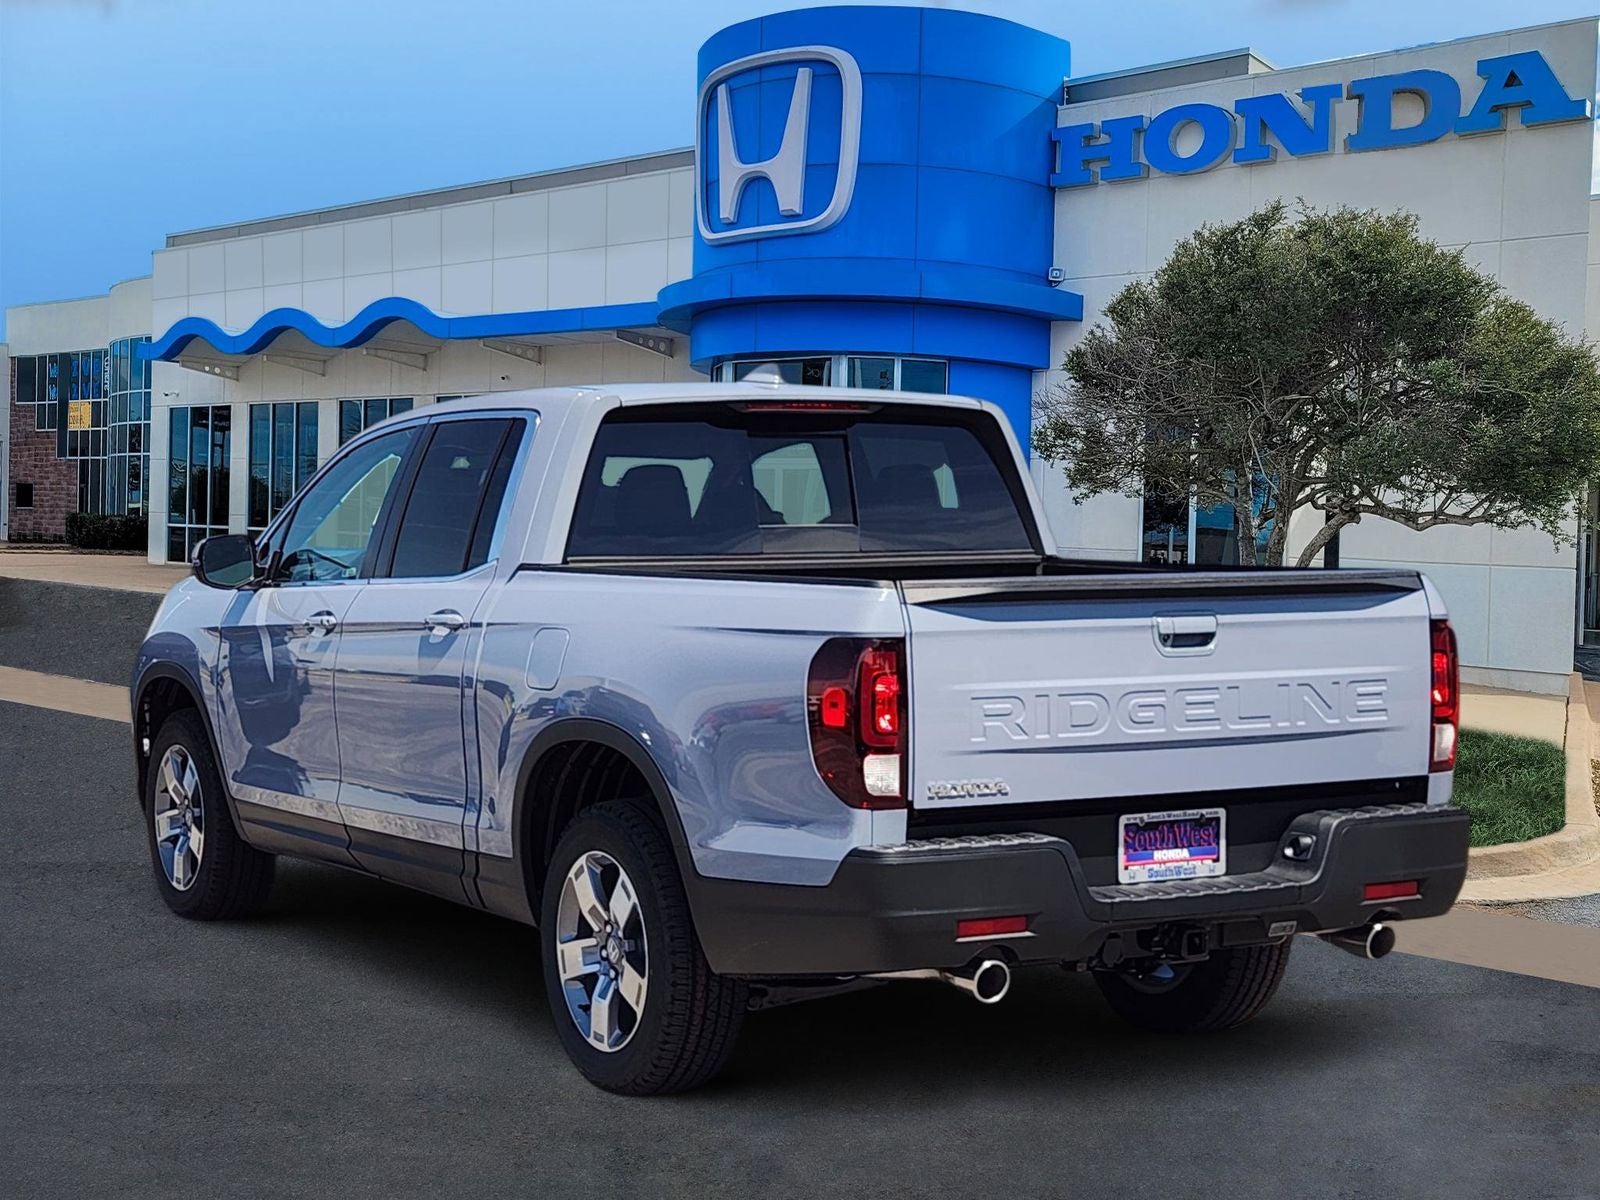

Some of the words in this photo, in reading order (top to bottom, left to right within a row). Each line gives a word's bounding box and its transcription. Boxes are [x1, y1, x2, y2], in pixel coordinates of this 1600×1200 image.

[1050, 50, 1591, 187] HONDA
[969, 678, 1390, 742] RIDGELINE
[1147, 865, 1197, 878] SouthWest
[1154, 848, 1190, 860] HONDA
